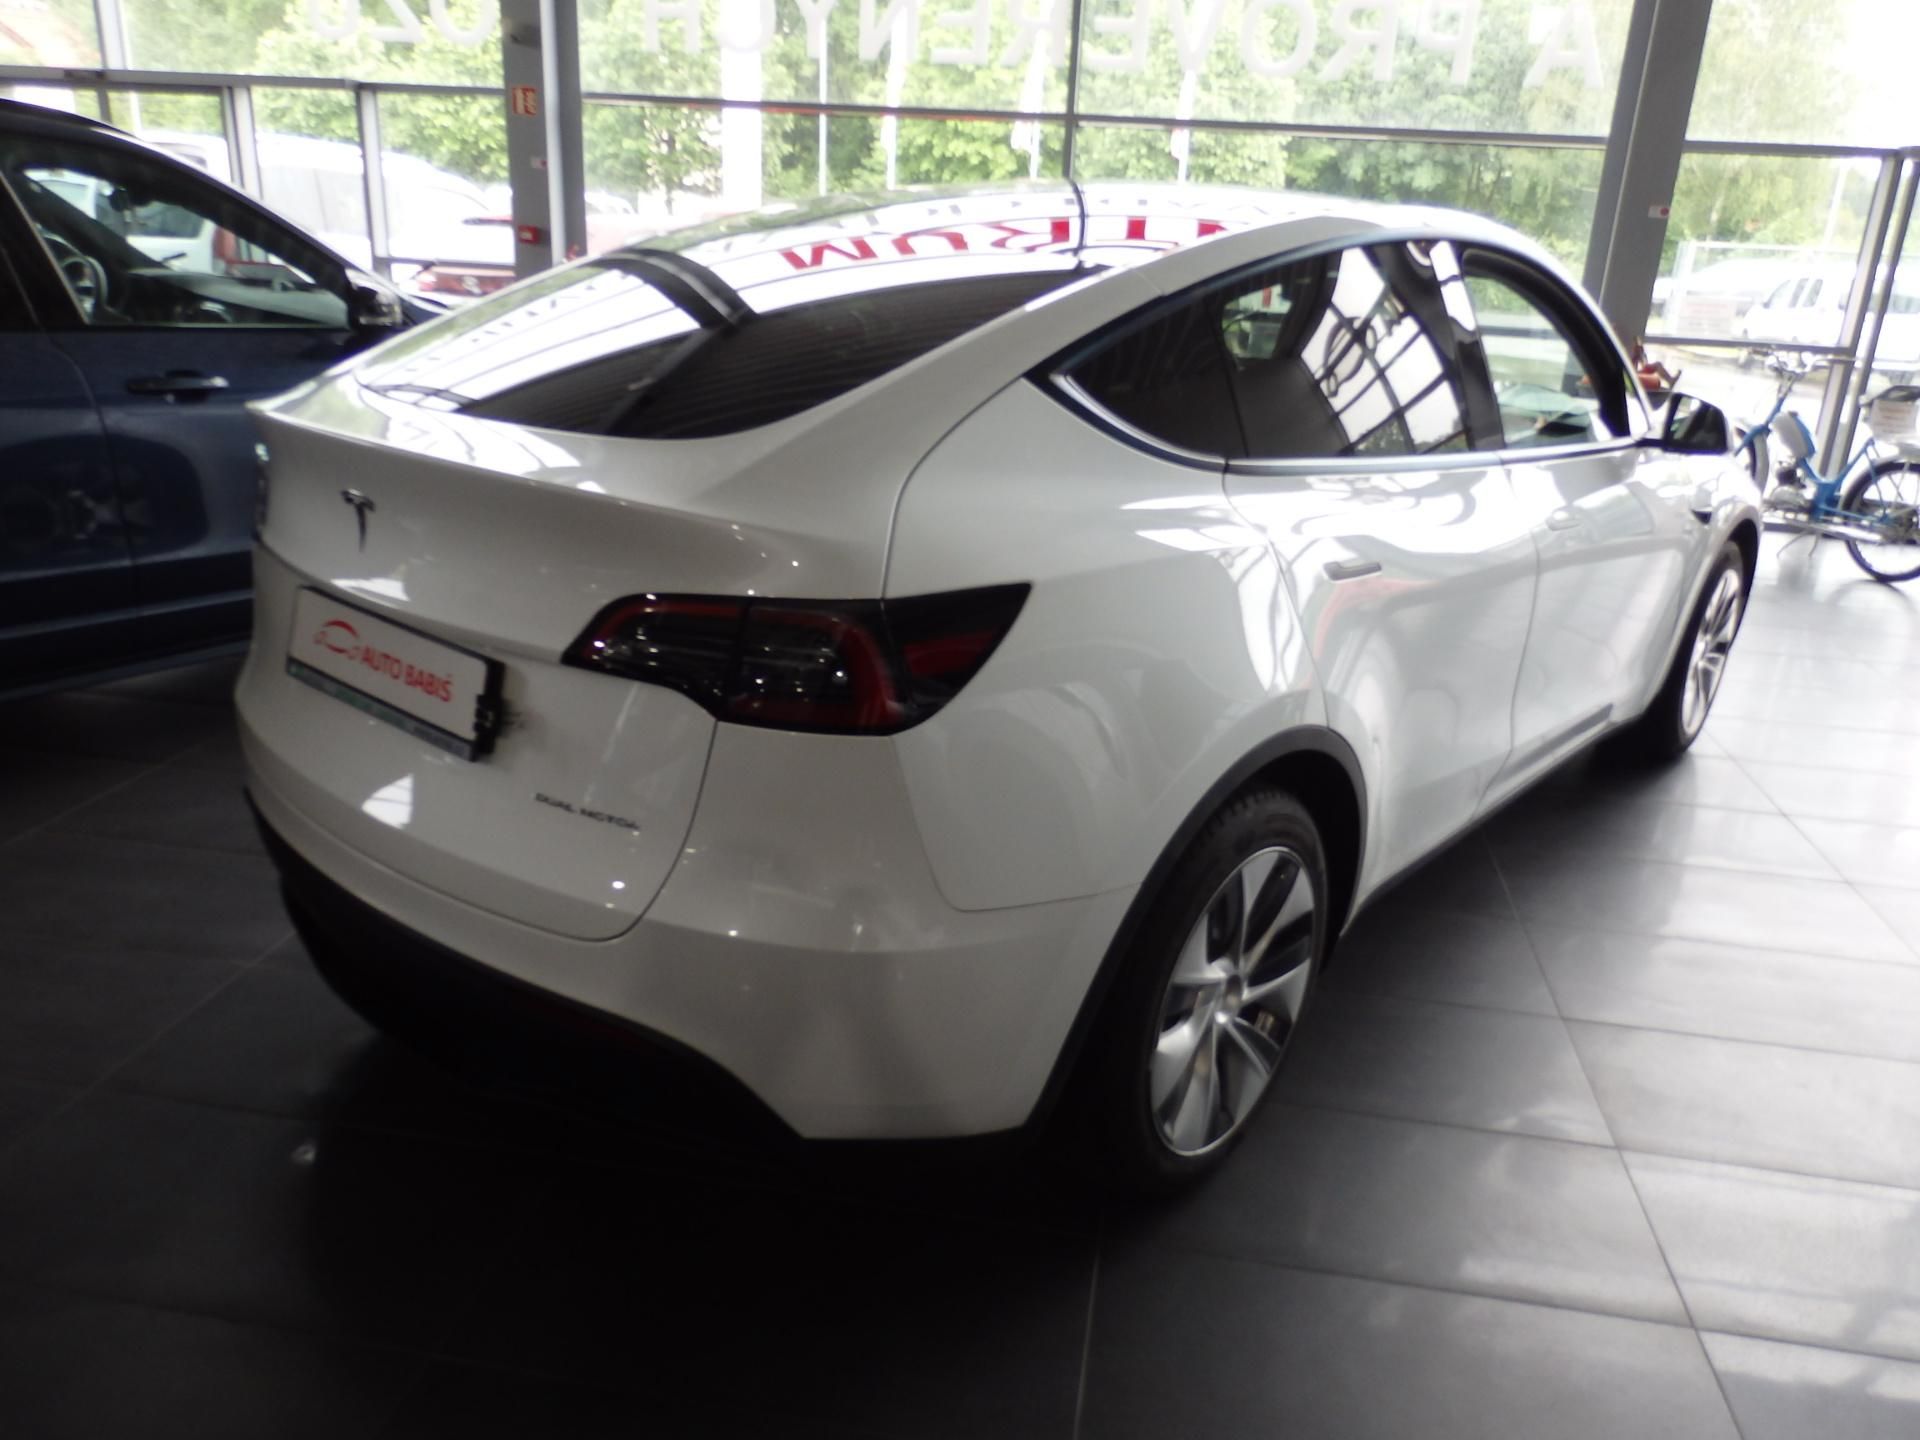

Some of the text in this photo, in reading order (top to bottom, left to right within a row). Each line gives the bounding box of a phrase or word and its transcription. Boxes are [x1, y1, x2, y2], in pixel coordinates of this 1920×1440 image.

[361, 646, 402, 681] AUTO
[534, 792, 640, 830] DUAL MOTOR
